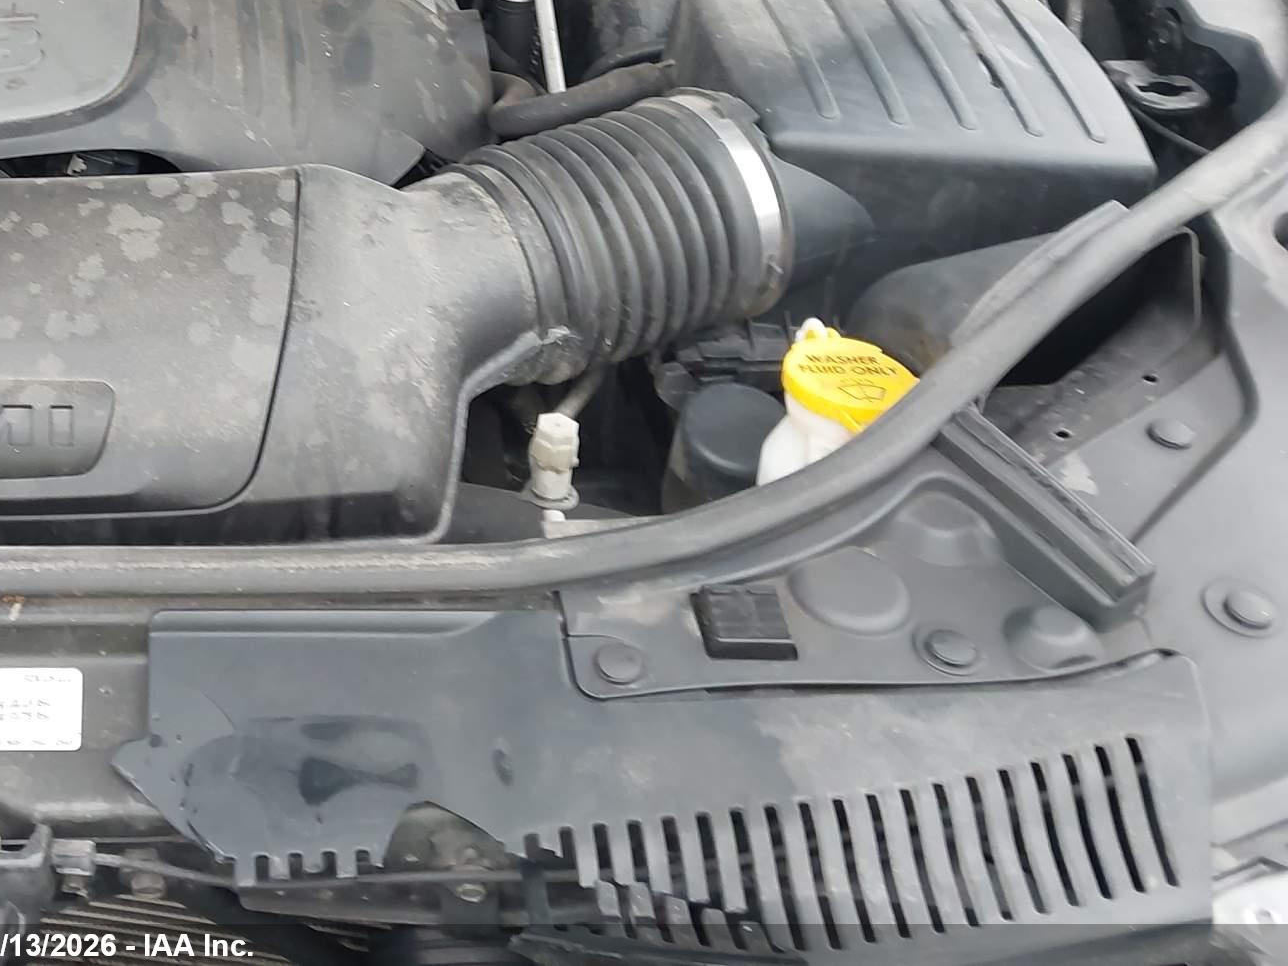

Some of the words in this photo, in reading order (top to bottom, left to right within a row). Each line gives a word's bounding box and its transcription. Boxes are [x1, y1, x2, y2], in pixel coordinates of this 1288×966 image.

[805, 353, 881, 365] WASHER
[797, 363, 847, 376] FLUID
[850, 365, 899, 377] ONLY
